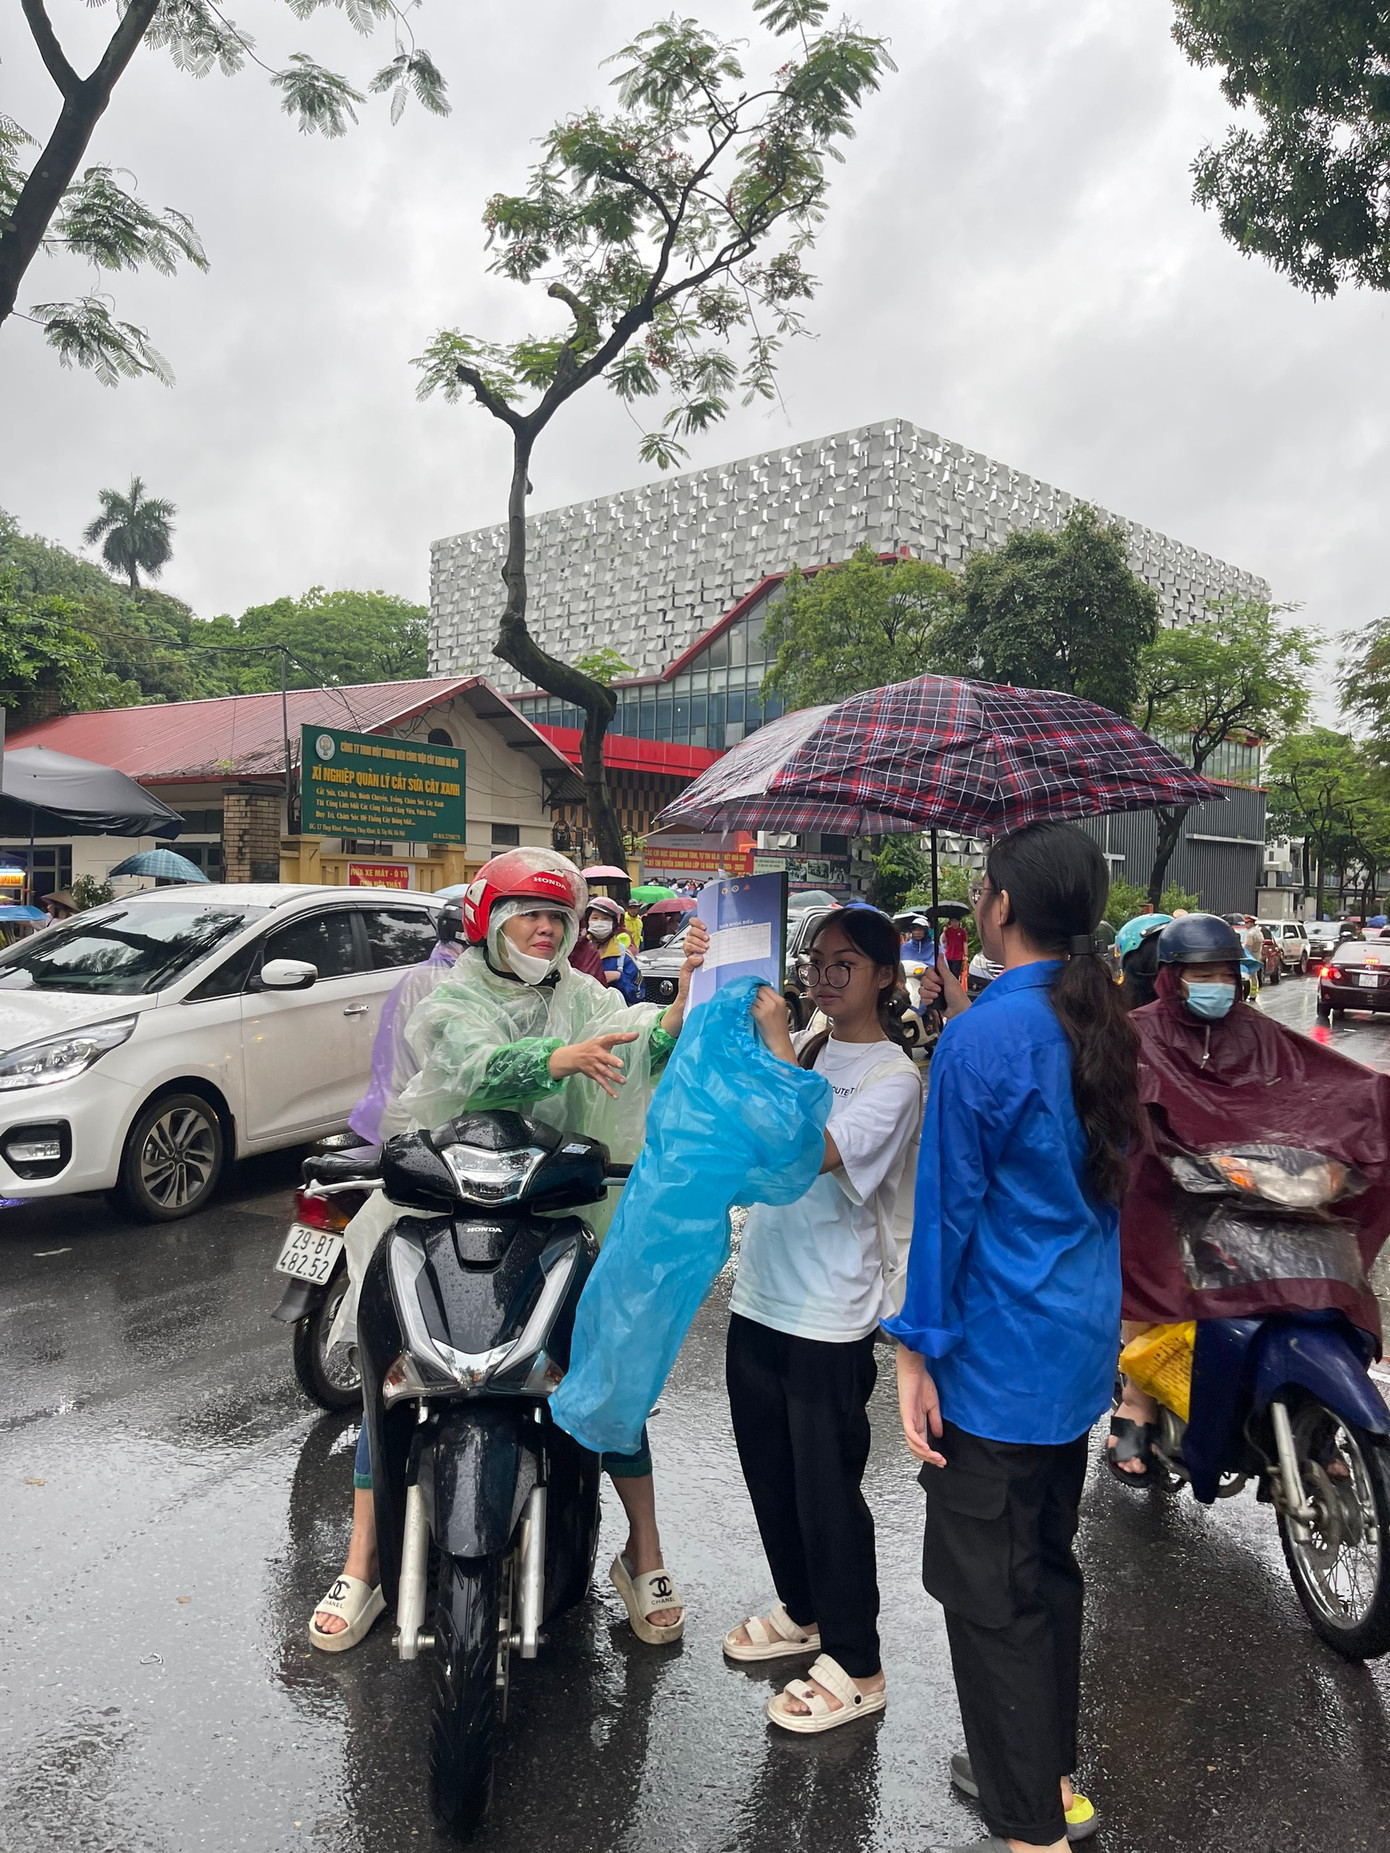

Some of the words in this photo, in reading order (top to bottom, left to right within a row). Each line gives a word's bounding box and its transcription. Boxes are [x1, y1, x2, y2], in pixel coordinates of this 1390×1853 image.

[312, 764, 322, 780] XÍ
[323, 767, 354, 786] NGHIỆP
[356, 768, 379, 787] QUẢN
[380, 773, 390, 789] LÝ
[391, 772, 406, 790] CẮT
[408, 773, 423, 793] SỬA
[425, 778, 440, 794] CÂY
[440, 781, 460, 797] XANH
[365, 868, 374, 877] XE
[374, 868, 389, 878] MÁY
[533, 877, 567, 890] HONDA
[292, 1229, 334, 1257] 29-B1
[280, 1250, 329, 1280] 482.52
[651, 1596, 676, 1606] CHANEL
